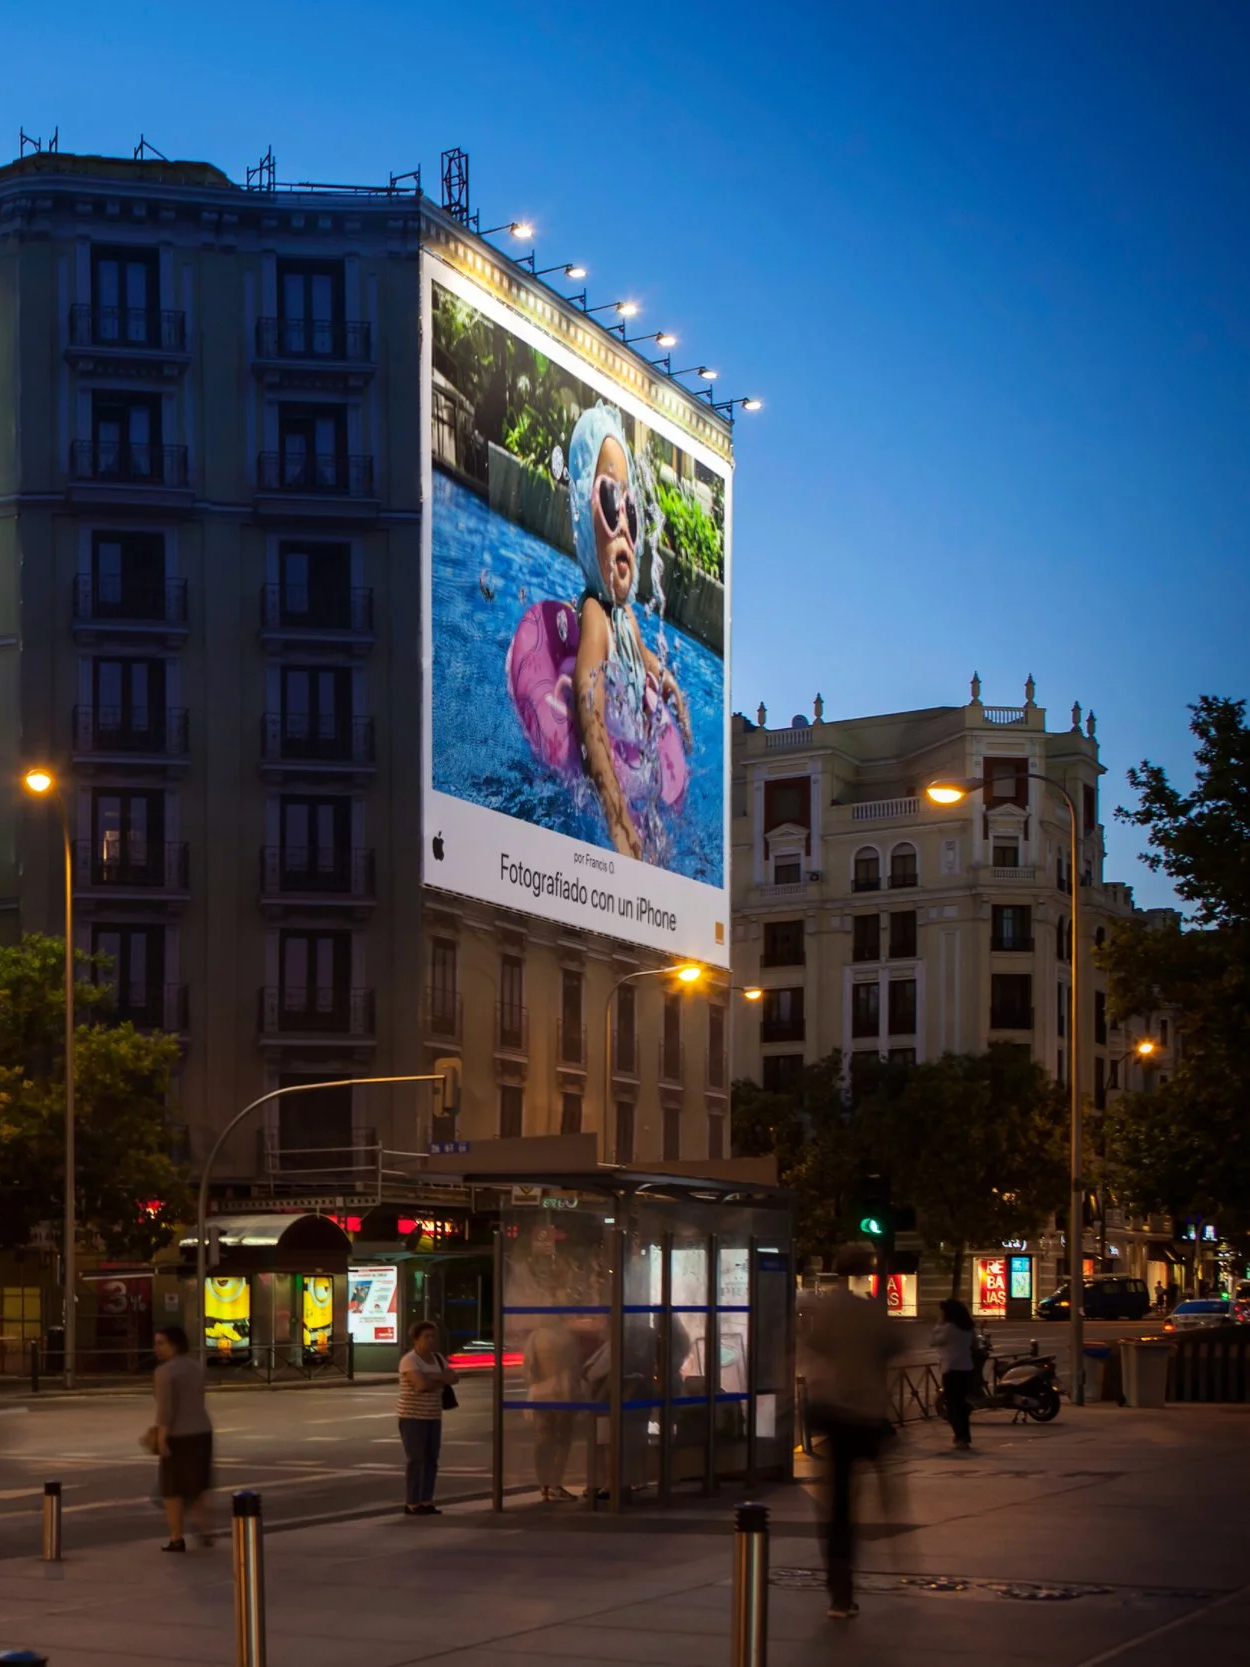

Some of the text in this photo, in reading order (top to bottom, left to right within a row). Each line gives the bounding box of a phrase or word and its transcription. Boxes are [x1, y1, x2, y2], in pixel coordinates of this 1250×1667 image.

[573, 852, 585, 864] por
[585, 853, 608, 873] Francis
[500, 853, 677, 932] Fotografiado con un iPhone
[986, 1260, 1005, 1274] RE
[987, 1275, 1005, 1289] BA
